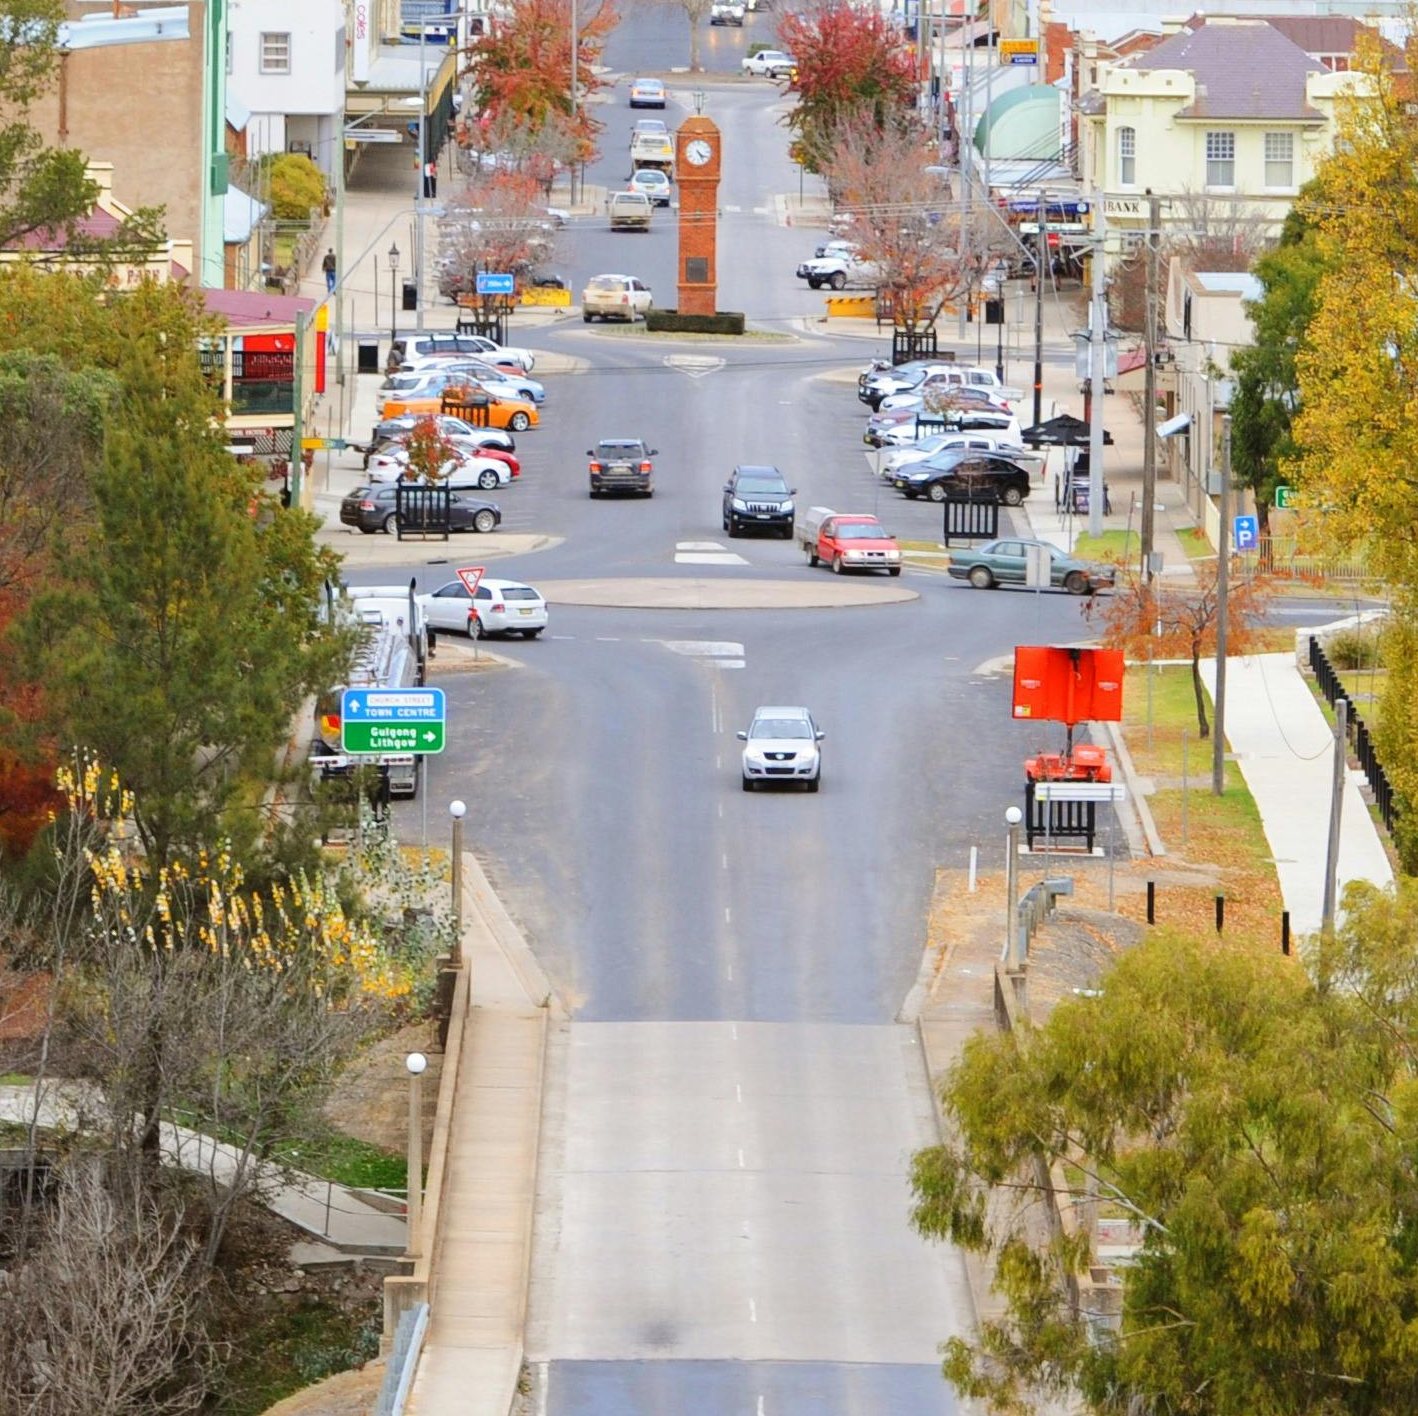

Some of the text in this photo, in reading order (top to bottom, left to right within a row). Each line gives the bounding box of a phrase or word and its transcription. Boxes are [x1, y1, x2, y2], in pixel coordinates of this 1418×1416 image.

[356, 4, 366, 40] coles
[1107, 200, 1140, 213] BANK
[1239, 531, 1252, 546] P
[365, 708, 436, 717] TOWN CENTRE
[370, 727, 417, 739] Gulgong
[370, 738, 417, 749] Lithgow
